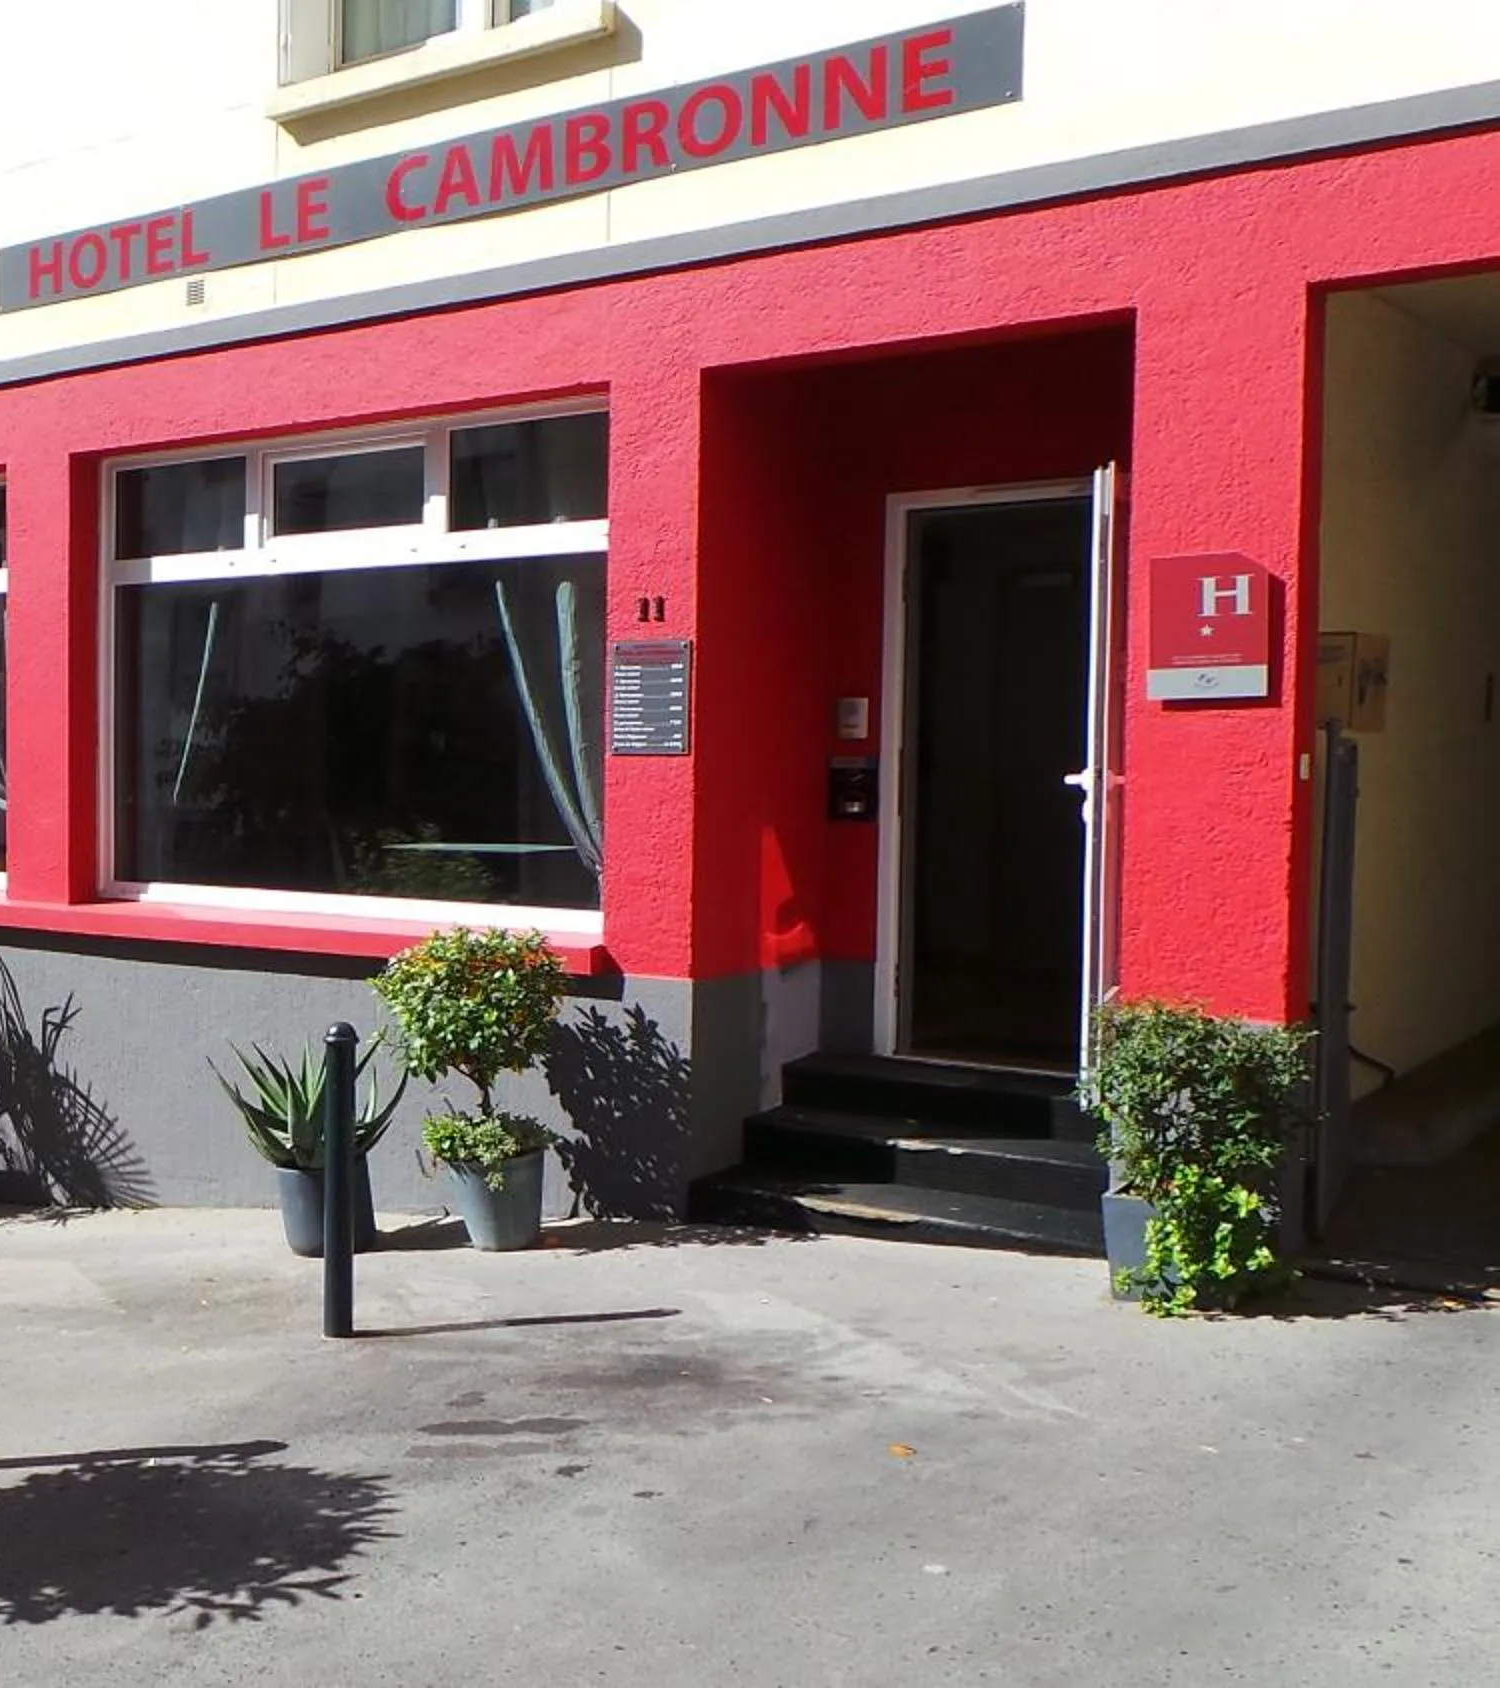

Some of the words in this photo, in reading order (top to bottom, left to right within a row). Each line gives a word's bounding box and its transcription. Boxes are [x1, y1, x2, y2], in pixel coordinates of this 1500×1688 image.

[28, 206, 211, 299] HOTEL
[259, 178, 329, 250] LE
[384, 27, 954, 223] CAMBRONNE
[637, 595, 666, 622] 11
[1197, 573, 1255, 617] H
